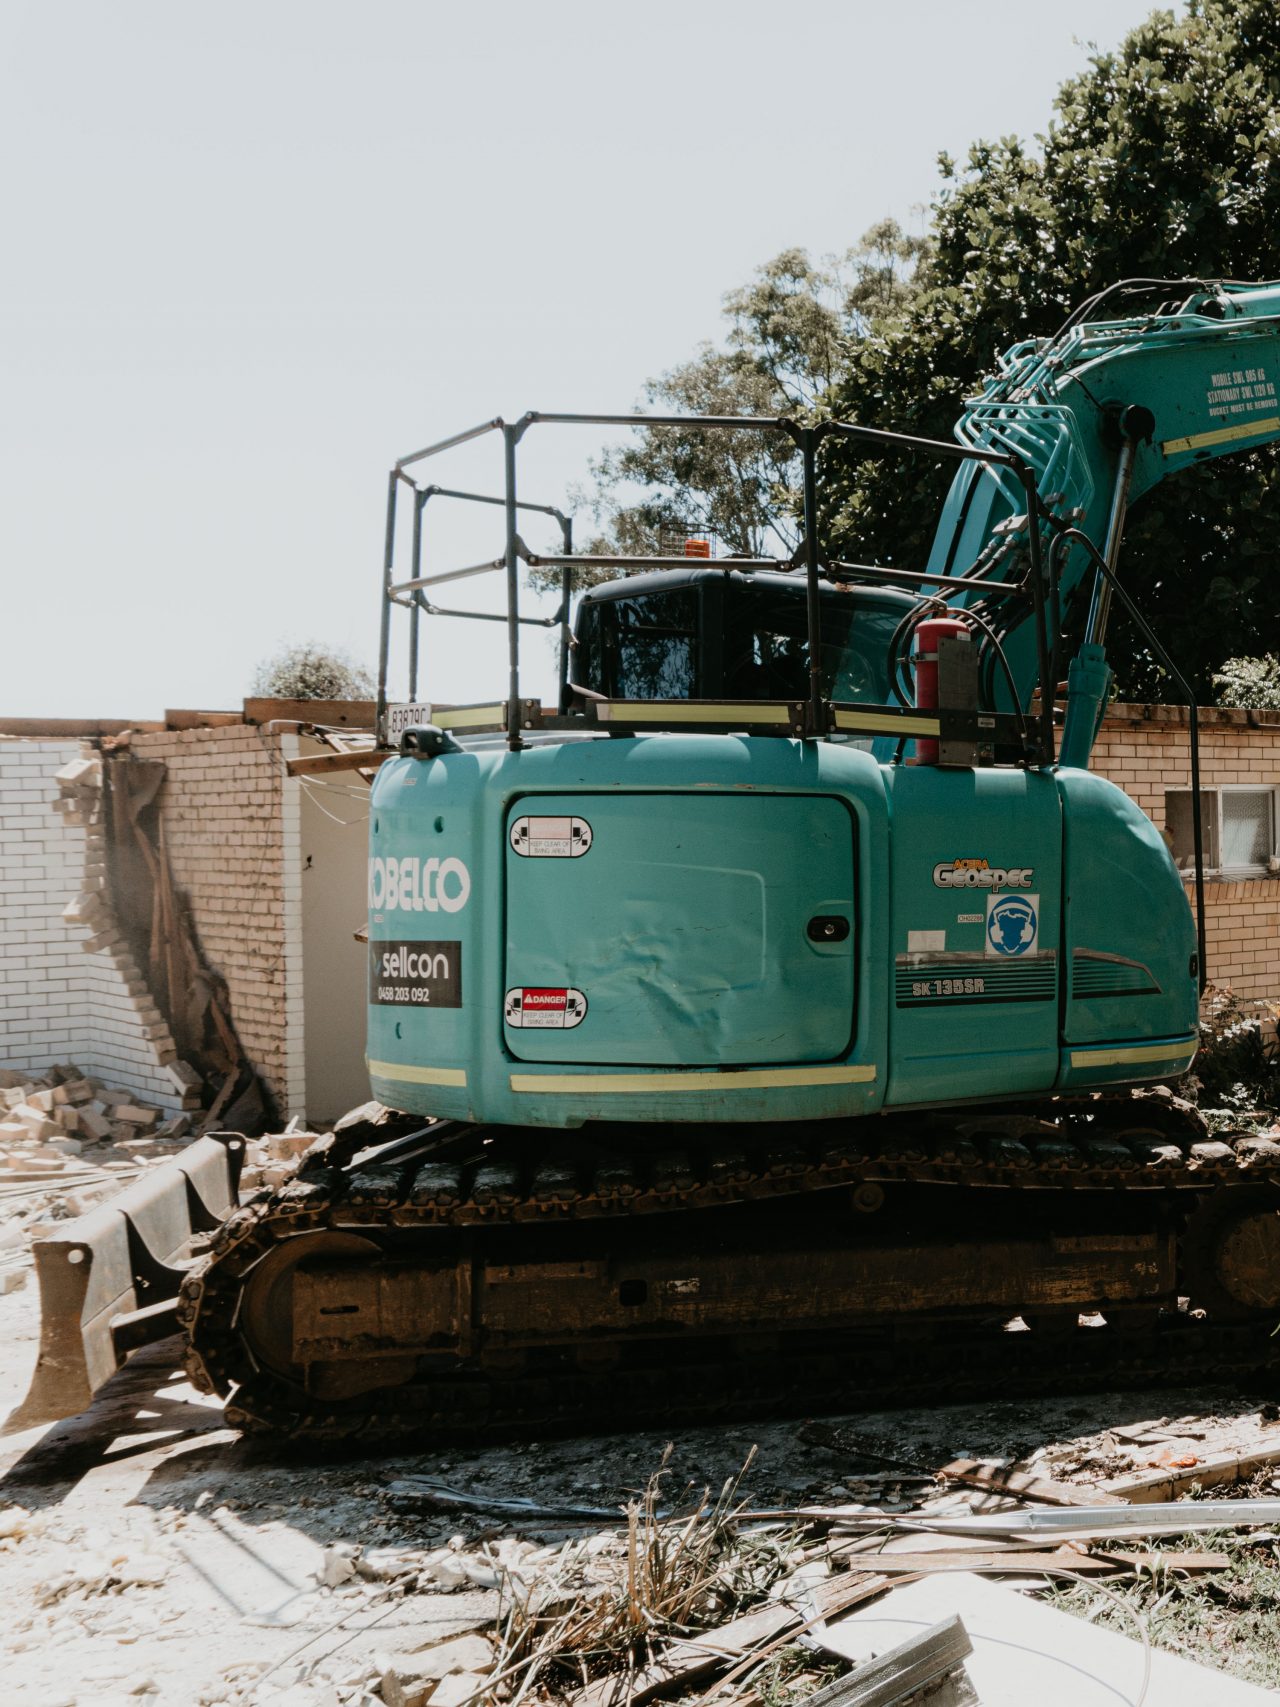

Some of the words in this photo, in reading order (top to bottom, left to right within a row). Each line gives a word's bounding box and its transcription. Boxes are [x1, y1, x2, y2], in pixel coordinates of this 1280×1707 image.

[1211, 373, 1232, 387] MOBILE
[1233, 371, 1245, 384] SWL
[1257, 368, 1265, 381] KG
[1207, 388, 1240, 404] STATIONARY
[1241, 386, 1254, 399] SWL
[1266, 383, 1275, 395] KG
[1209, 406, 1229, 416] BUCKET
[1231, 403, 1245, 413] MUST
[1246, 402, 1253, 411] BE
[1254, 398, 1278, 409] REMOVED
[383, 946, 449, 979] sellcon
[378, 987, 394, 1000] 0458
[395, 987, 410, 1001] 203
[411, 988, 430, 1002] 092
[912, 982, 931, 996] SK
[934, 978, 985, 995] 135SR
[533, 996, 566, 1004] DANGER
